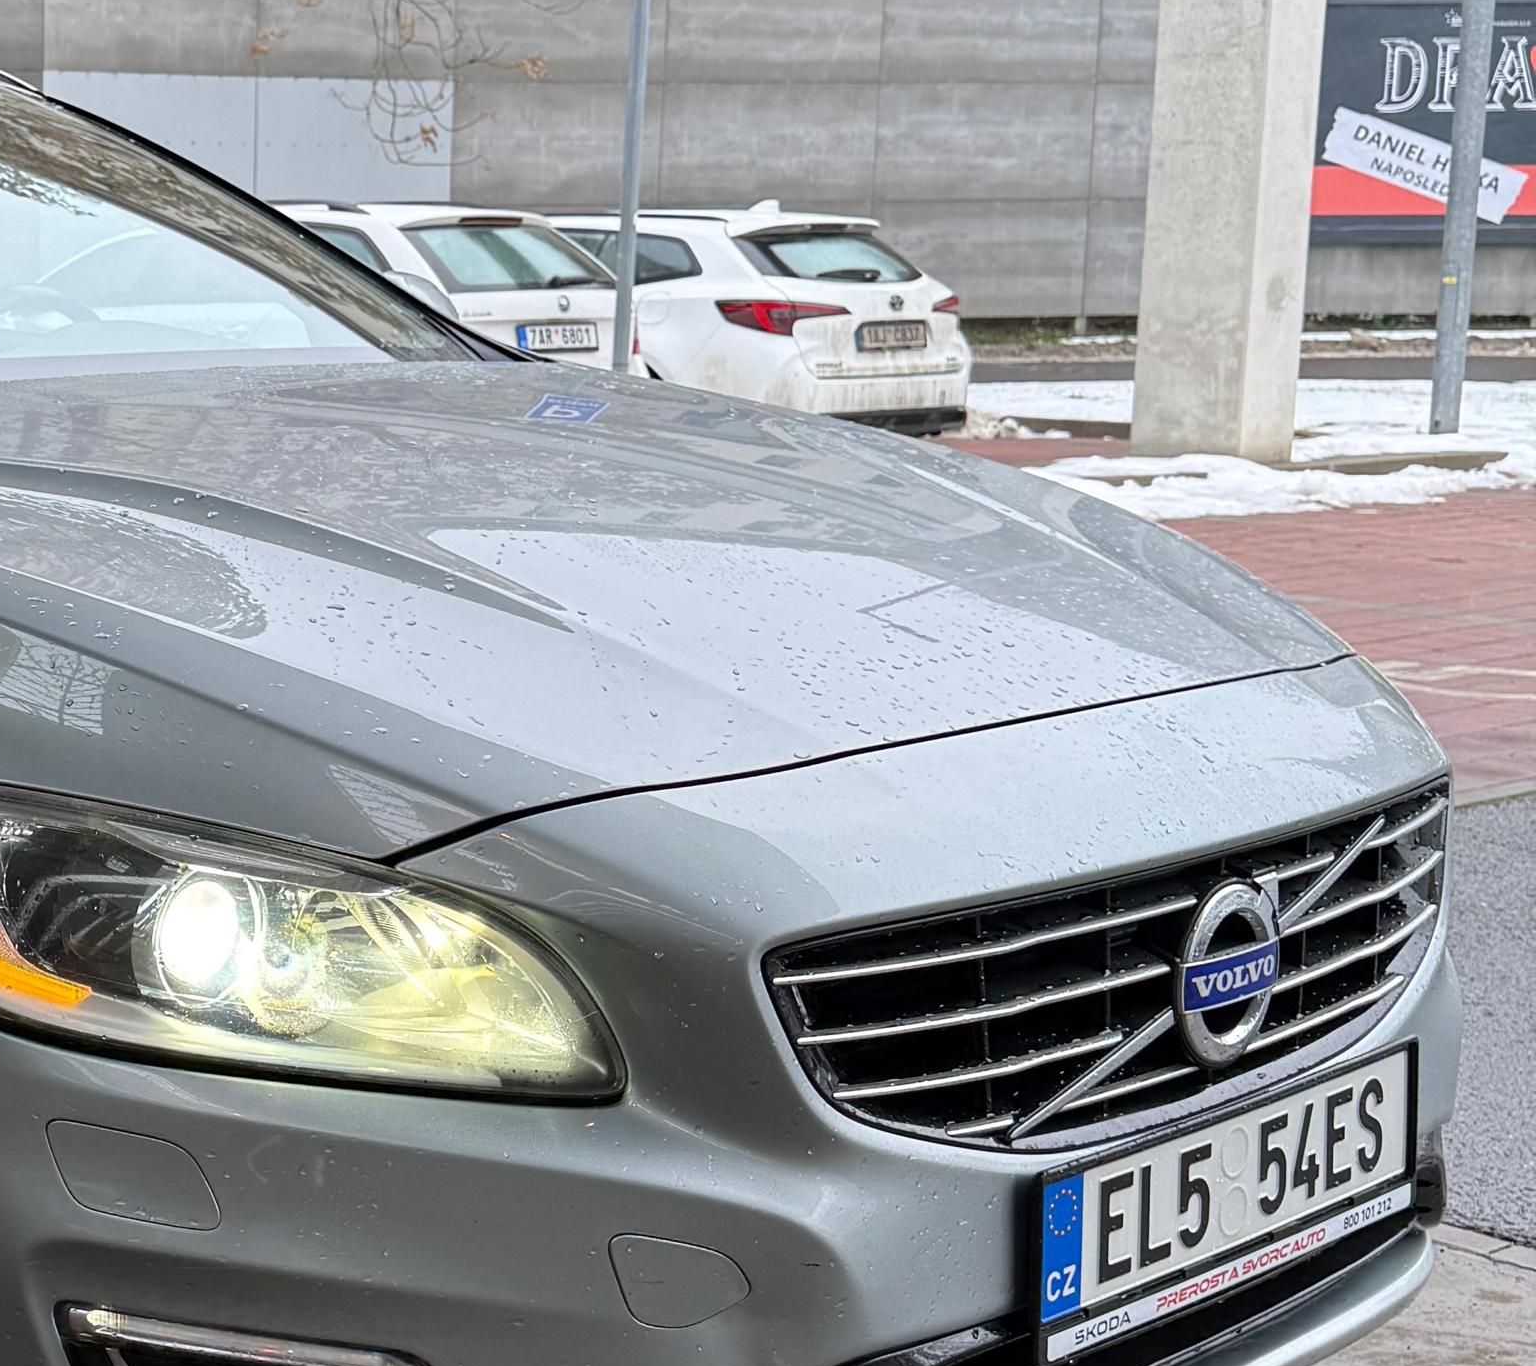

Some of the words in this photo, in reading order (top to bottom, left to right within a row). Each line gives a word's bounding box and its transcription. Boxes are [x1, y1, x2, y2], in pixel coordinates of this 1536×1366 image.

[1353, 124, 1426, 166] DANIEL
[1191, 954, 1275, 998] VOLVO
[1098, 1142, 1212, 1285] EL5
[1258, 1077, 1384, 1215] 54ES
[1343, 1211, 1360, 1231] 800
[1361, 1205, 1375, 1224] 101
[1377, 1196, 1393, 1216] 212
[1291, 1227, 1327, 1255] AUTO
[1046, 1263, 1077, 1303] CZ
